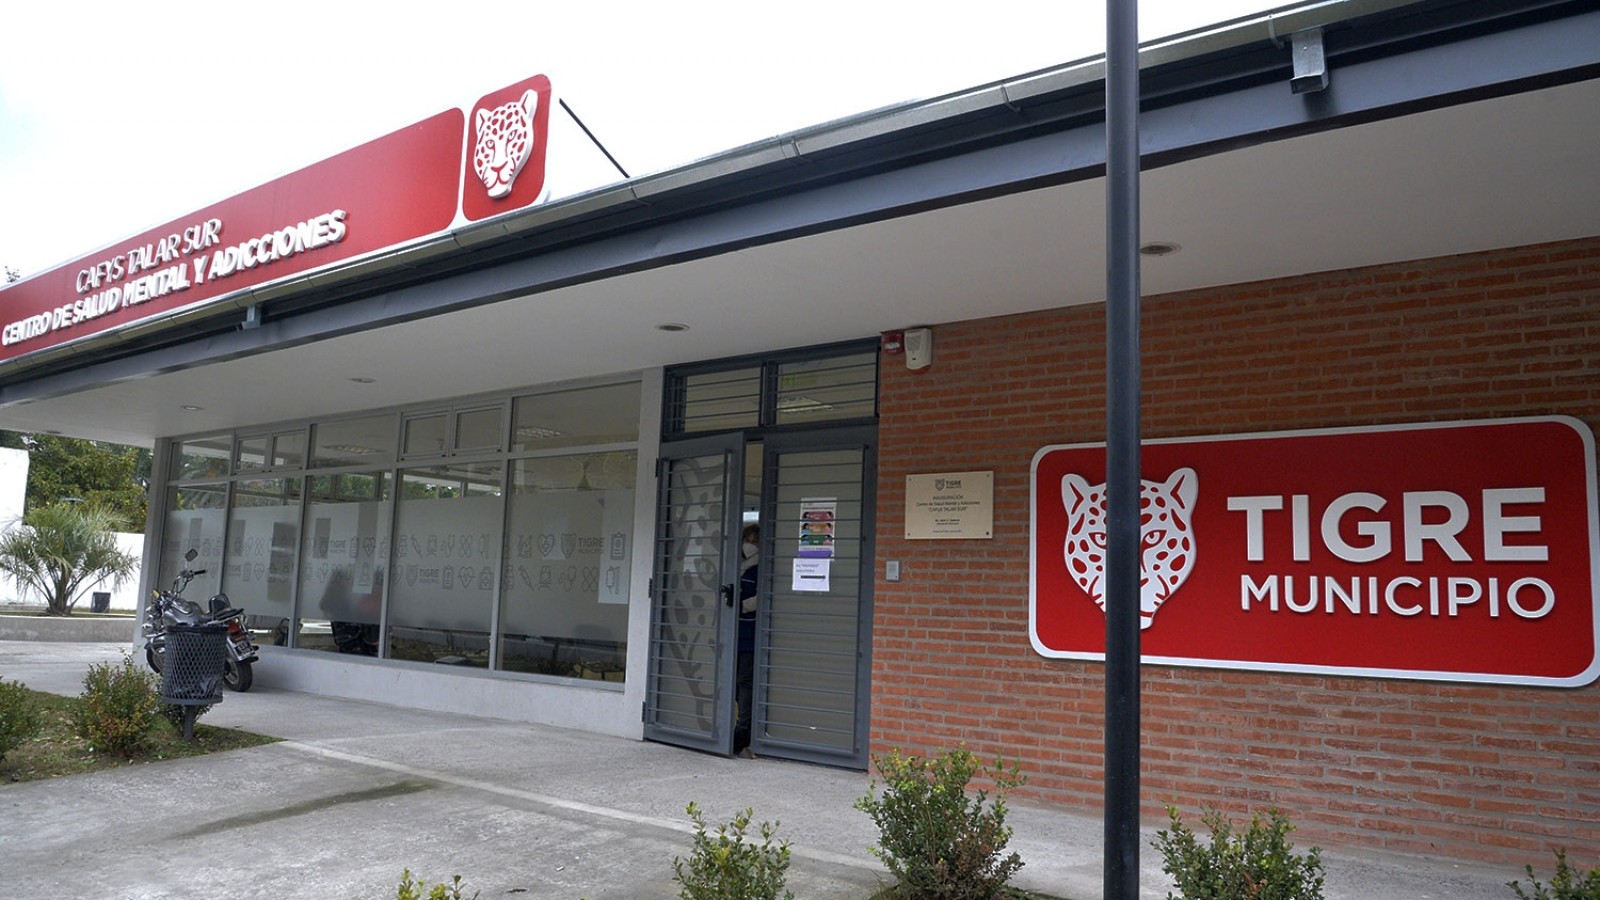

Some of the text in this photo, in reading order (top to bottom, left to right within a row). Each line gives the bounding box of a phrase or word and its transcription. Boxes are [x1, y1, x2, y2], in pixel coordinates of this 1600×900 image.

[2, 208, 347, 346] CENTRO DE SALUD MENTAL Y ADICCIONES
[76, 218, 222, 293] CAFYS TALAR SUR
[578, 537, 605, 548] TIGRE
[1227, 487, 1549, 563] TIGRE
[419, 568, 440, 578] TIGRE
[1241, 574, 1555, 619] MUNICIPIO
